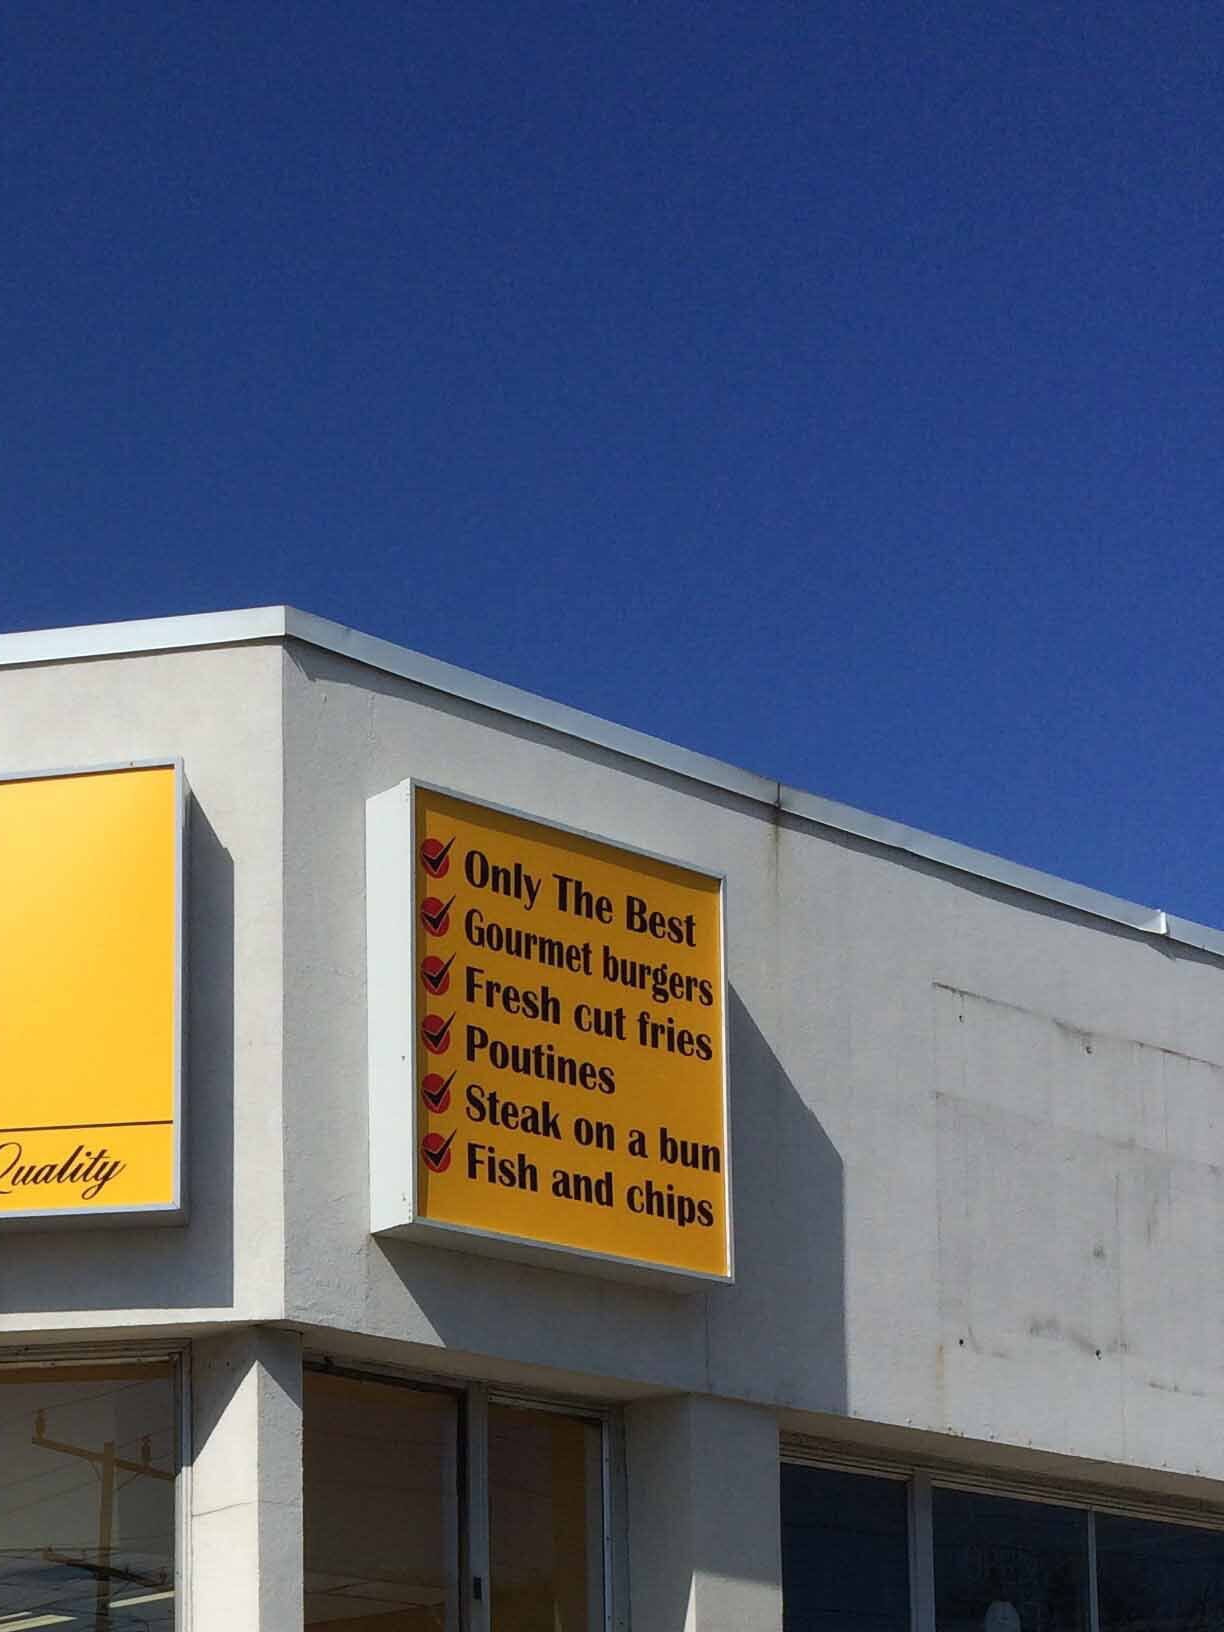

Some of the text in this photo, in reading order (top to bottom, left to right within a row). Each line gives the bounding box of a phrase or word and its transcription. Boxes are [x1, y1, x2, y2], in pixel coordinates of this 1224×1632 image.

[464, 849, 697, 948] Only The Best
[464, 908, 714, 1007] Gourmet burgers
[465, 966, 713, 1061] Fresh cut fries
[465, 1024, 617, 1095] Poutines
[465, 1083, 721, 1174] Steak on a bun
[466, 1142, 715, 1228] Fish and chips
